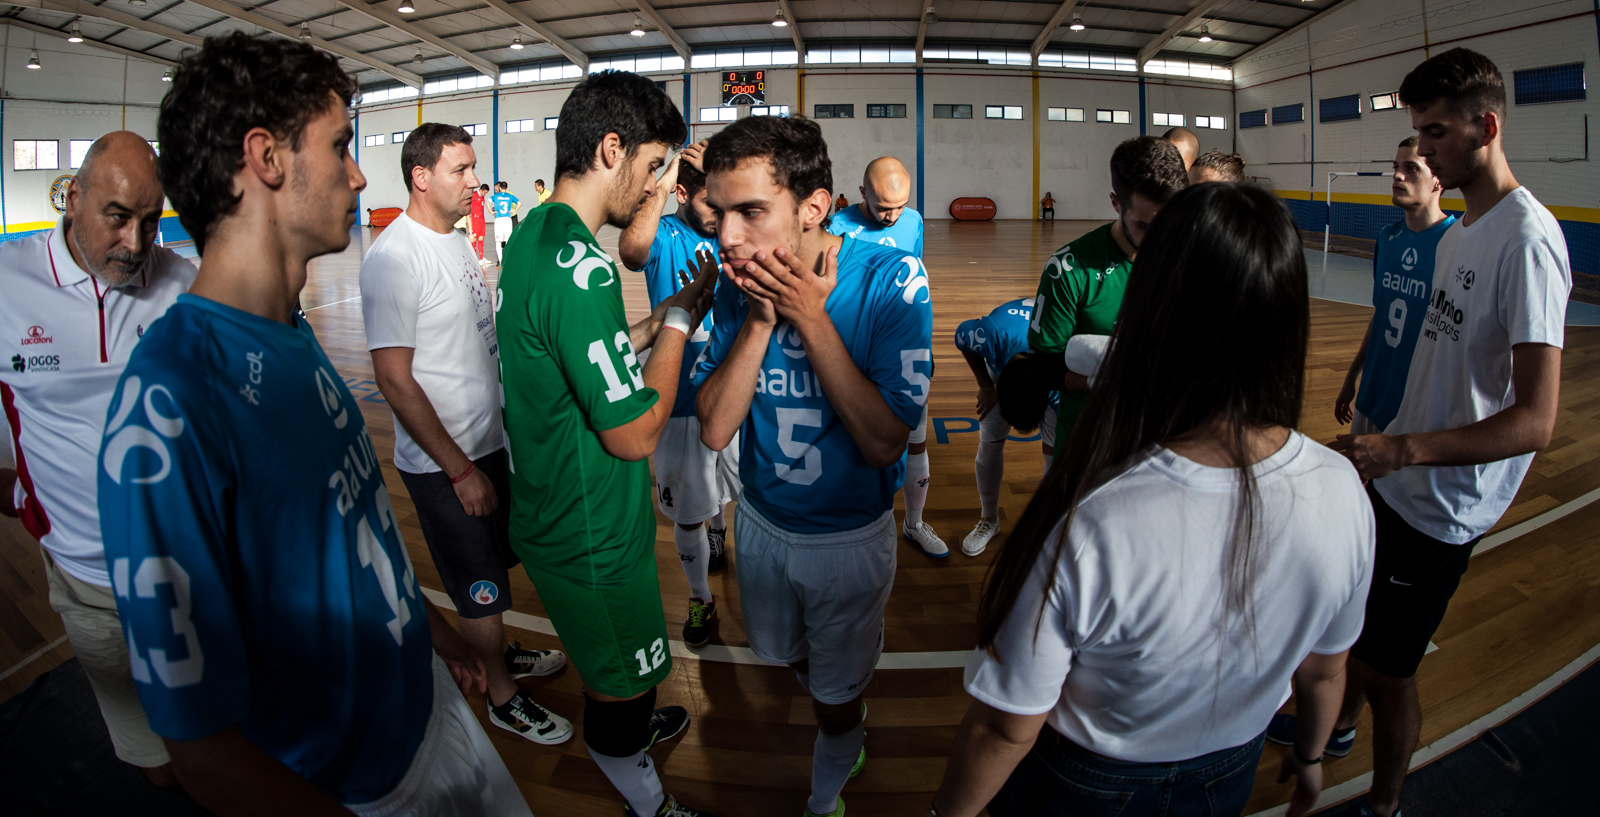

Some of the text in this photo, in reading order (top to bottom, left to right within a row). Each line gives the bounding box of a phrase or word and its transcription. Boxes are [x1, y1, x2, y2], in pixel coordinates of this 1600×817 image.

[723, 82, 764, 94] 0 00:00 0
[730, 72, 762, 80] 0 0
[499, 201, 508, 215] 3
[1382, 271, 1427, 299] aaum
[1384, 298, 1408, 349] 9
[28, 355, 60, 370] JOGOS
[249, 351, 263, 384] cdt
[587, 330, 645, 403] 12
[900, 348, 931, 407] 5
[774, 407, 823, 486] 5
[113, 556, 204, 689] 13
[634, 637, 666, 676] 12
